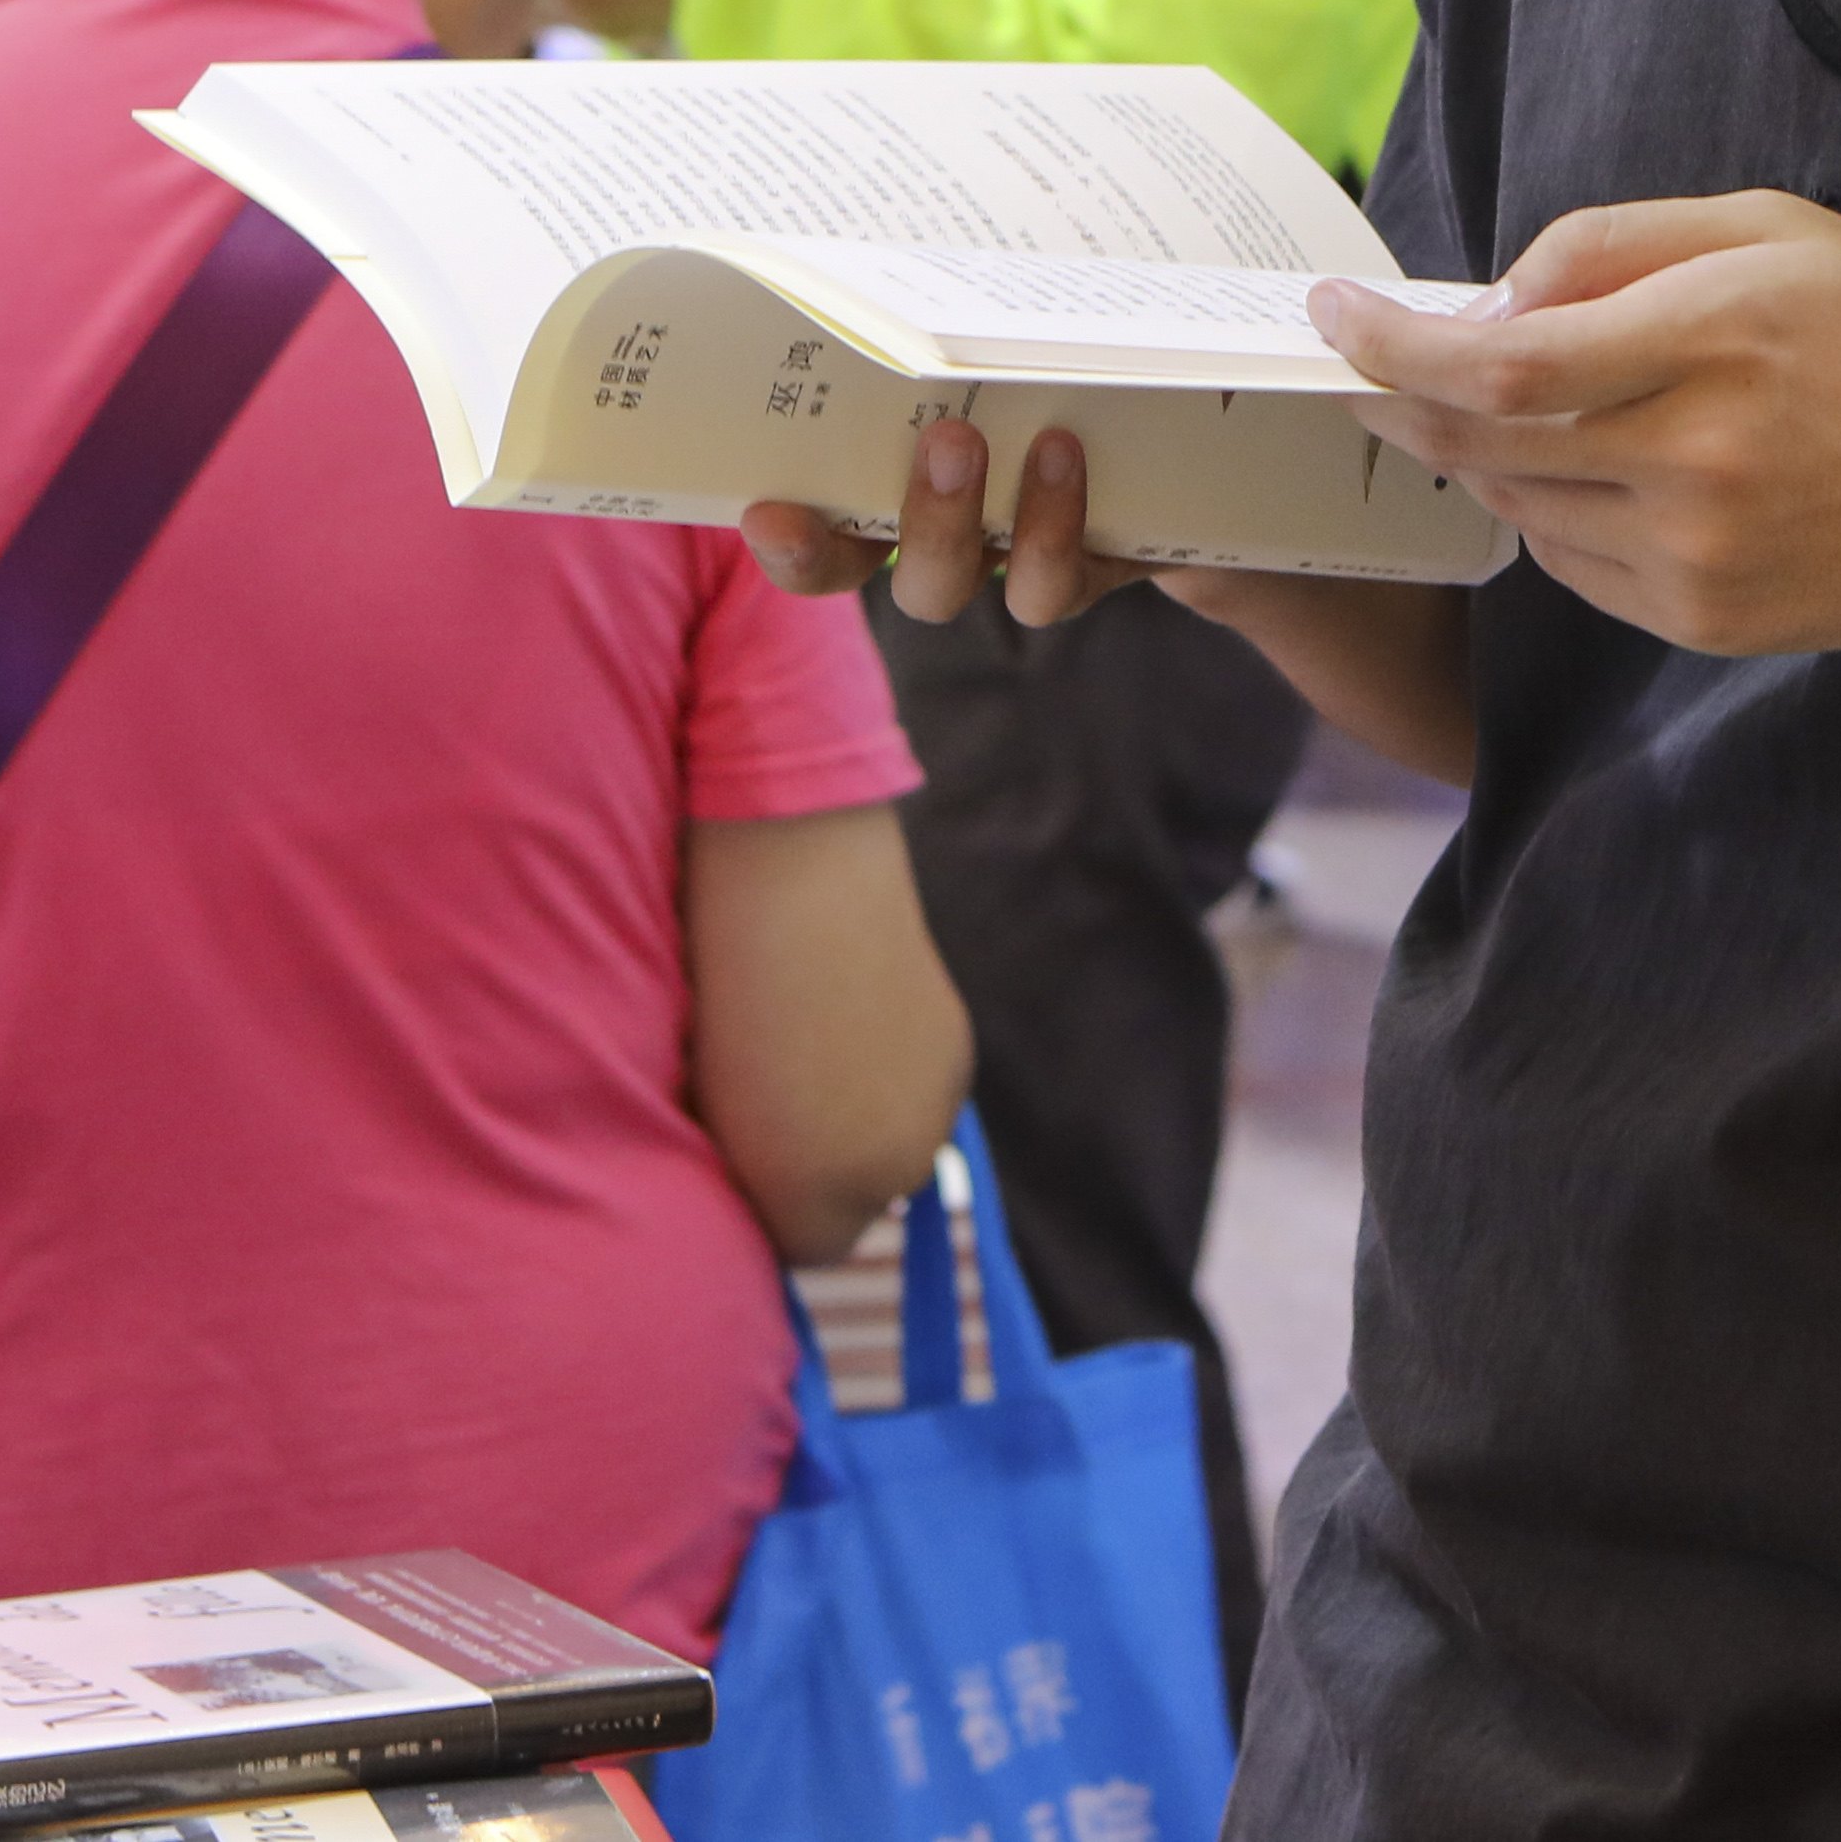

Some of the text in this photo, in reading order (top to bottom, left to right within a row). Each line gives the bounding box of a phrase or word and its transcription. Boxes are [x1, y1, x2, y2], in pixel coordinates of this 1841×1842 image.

[593, 361, 626, 409] 中国
[619, 325, 668, 411] 材质艺术
[766, 339, 824, 419] 巫鸿
